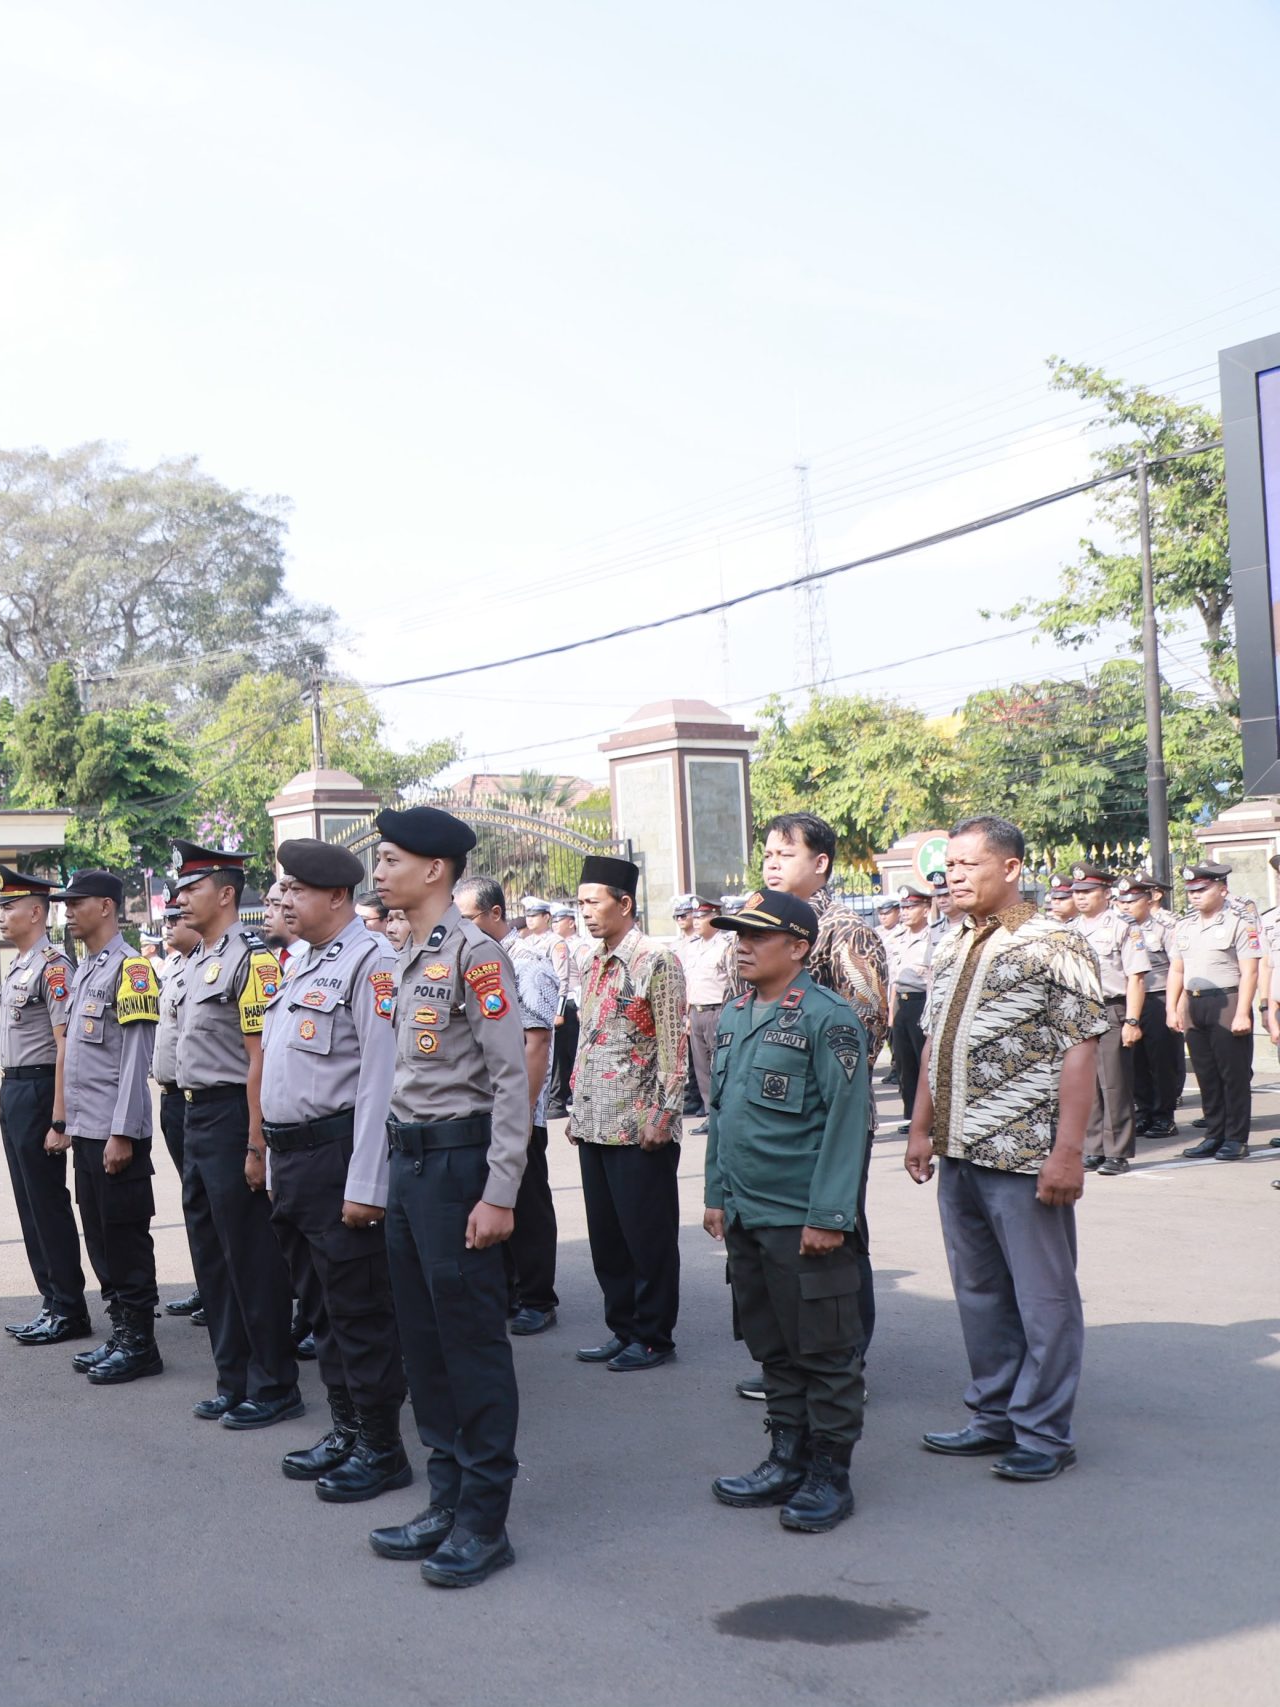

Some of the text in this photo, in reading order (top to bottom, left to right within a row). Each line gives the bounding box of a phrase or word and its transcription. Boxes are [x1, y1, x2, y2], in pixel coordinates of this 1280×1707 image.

[467, 963, 498, 980] POLRES
[311, 978, 342, 990] POLRI
[414, 985, 452, 1001] POLRI
[244, 1004, 267, 1019] BHABIN
[766, 1031, 805, 1048] POLHUT
